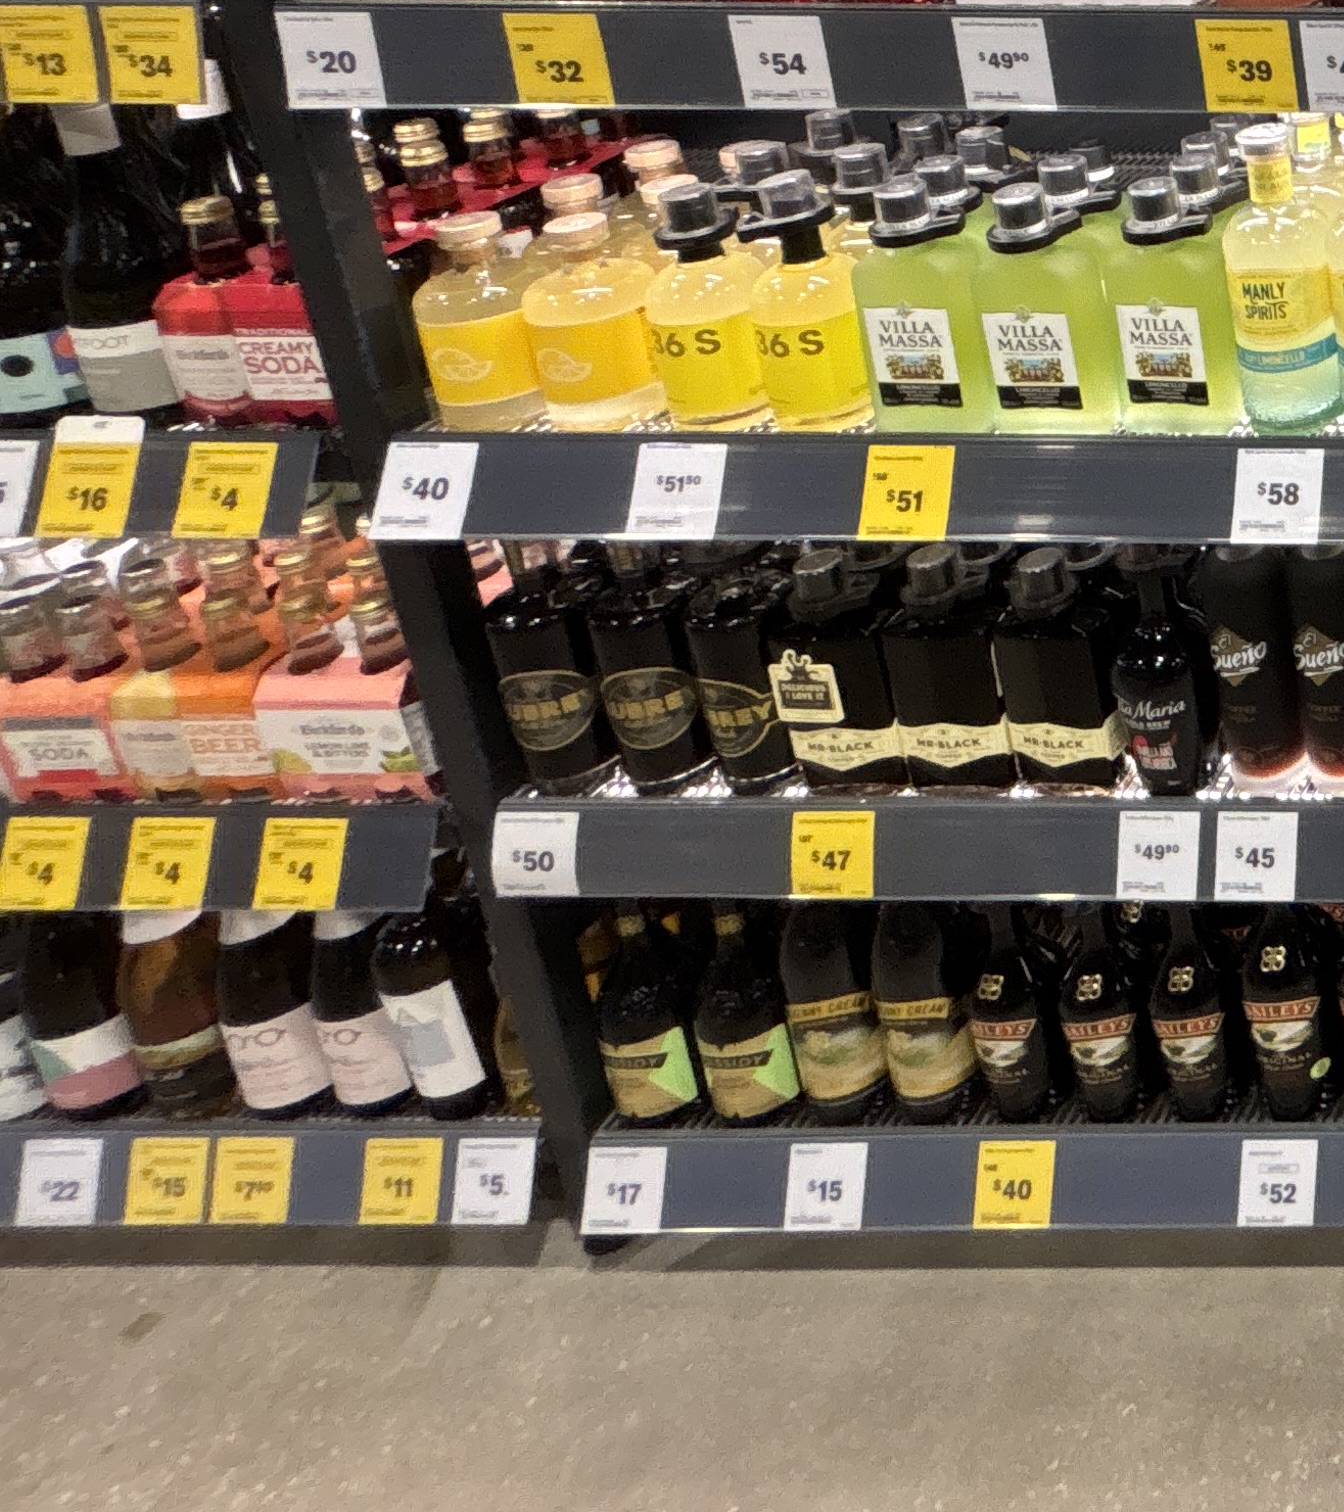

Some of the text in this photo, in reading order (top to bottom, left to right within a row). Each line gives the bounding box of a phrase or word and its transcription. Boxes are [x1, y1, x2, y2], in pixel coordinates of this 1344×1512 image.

[307, 51, 356, 73] $20
[536, 60, 583, 83] $32
[1227, 60, 1272, 82] $39
[1242, 281, 1287, 303] MANLY
[1245, 300, 1288, 321] SPIRITS
[879, 319, 934, 334] VILLA
[998, 324, 1054, 338] VILLA
[1131, 317, 1186, 332] VILLA
[239, 341, 314, 356] CREAMY
[879, 333, 942, 349] MASSA
[997, 337, 1062, 352] MASSA
[1130, 331, 1193, 347] MASSA
[243, 356, 322, 376] SODA
[403, 477, 449, 500] $40
[1258, 483, 1299, 505] $58
[887, 489, 923, 512] $51
[1134, 699, 1187, 719] Maria
[189, 738, 262, 754] BEER
[812, 850, 850, 870] $47
[384, 1177, 413, 1197] $11
[480, 1174, 507, 1195] $5
[608, 1183, 641, 1205] $17
[808, 1180, 842, 1201] $15
[993, 1179, 1032, 1200] $40
